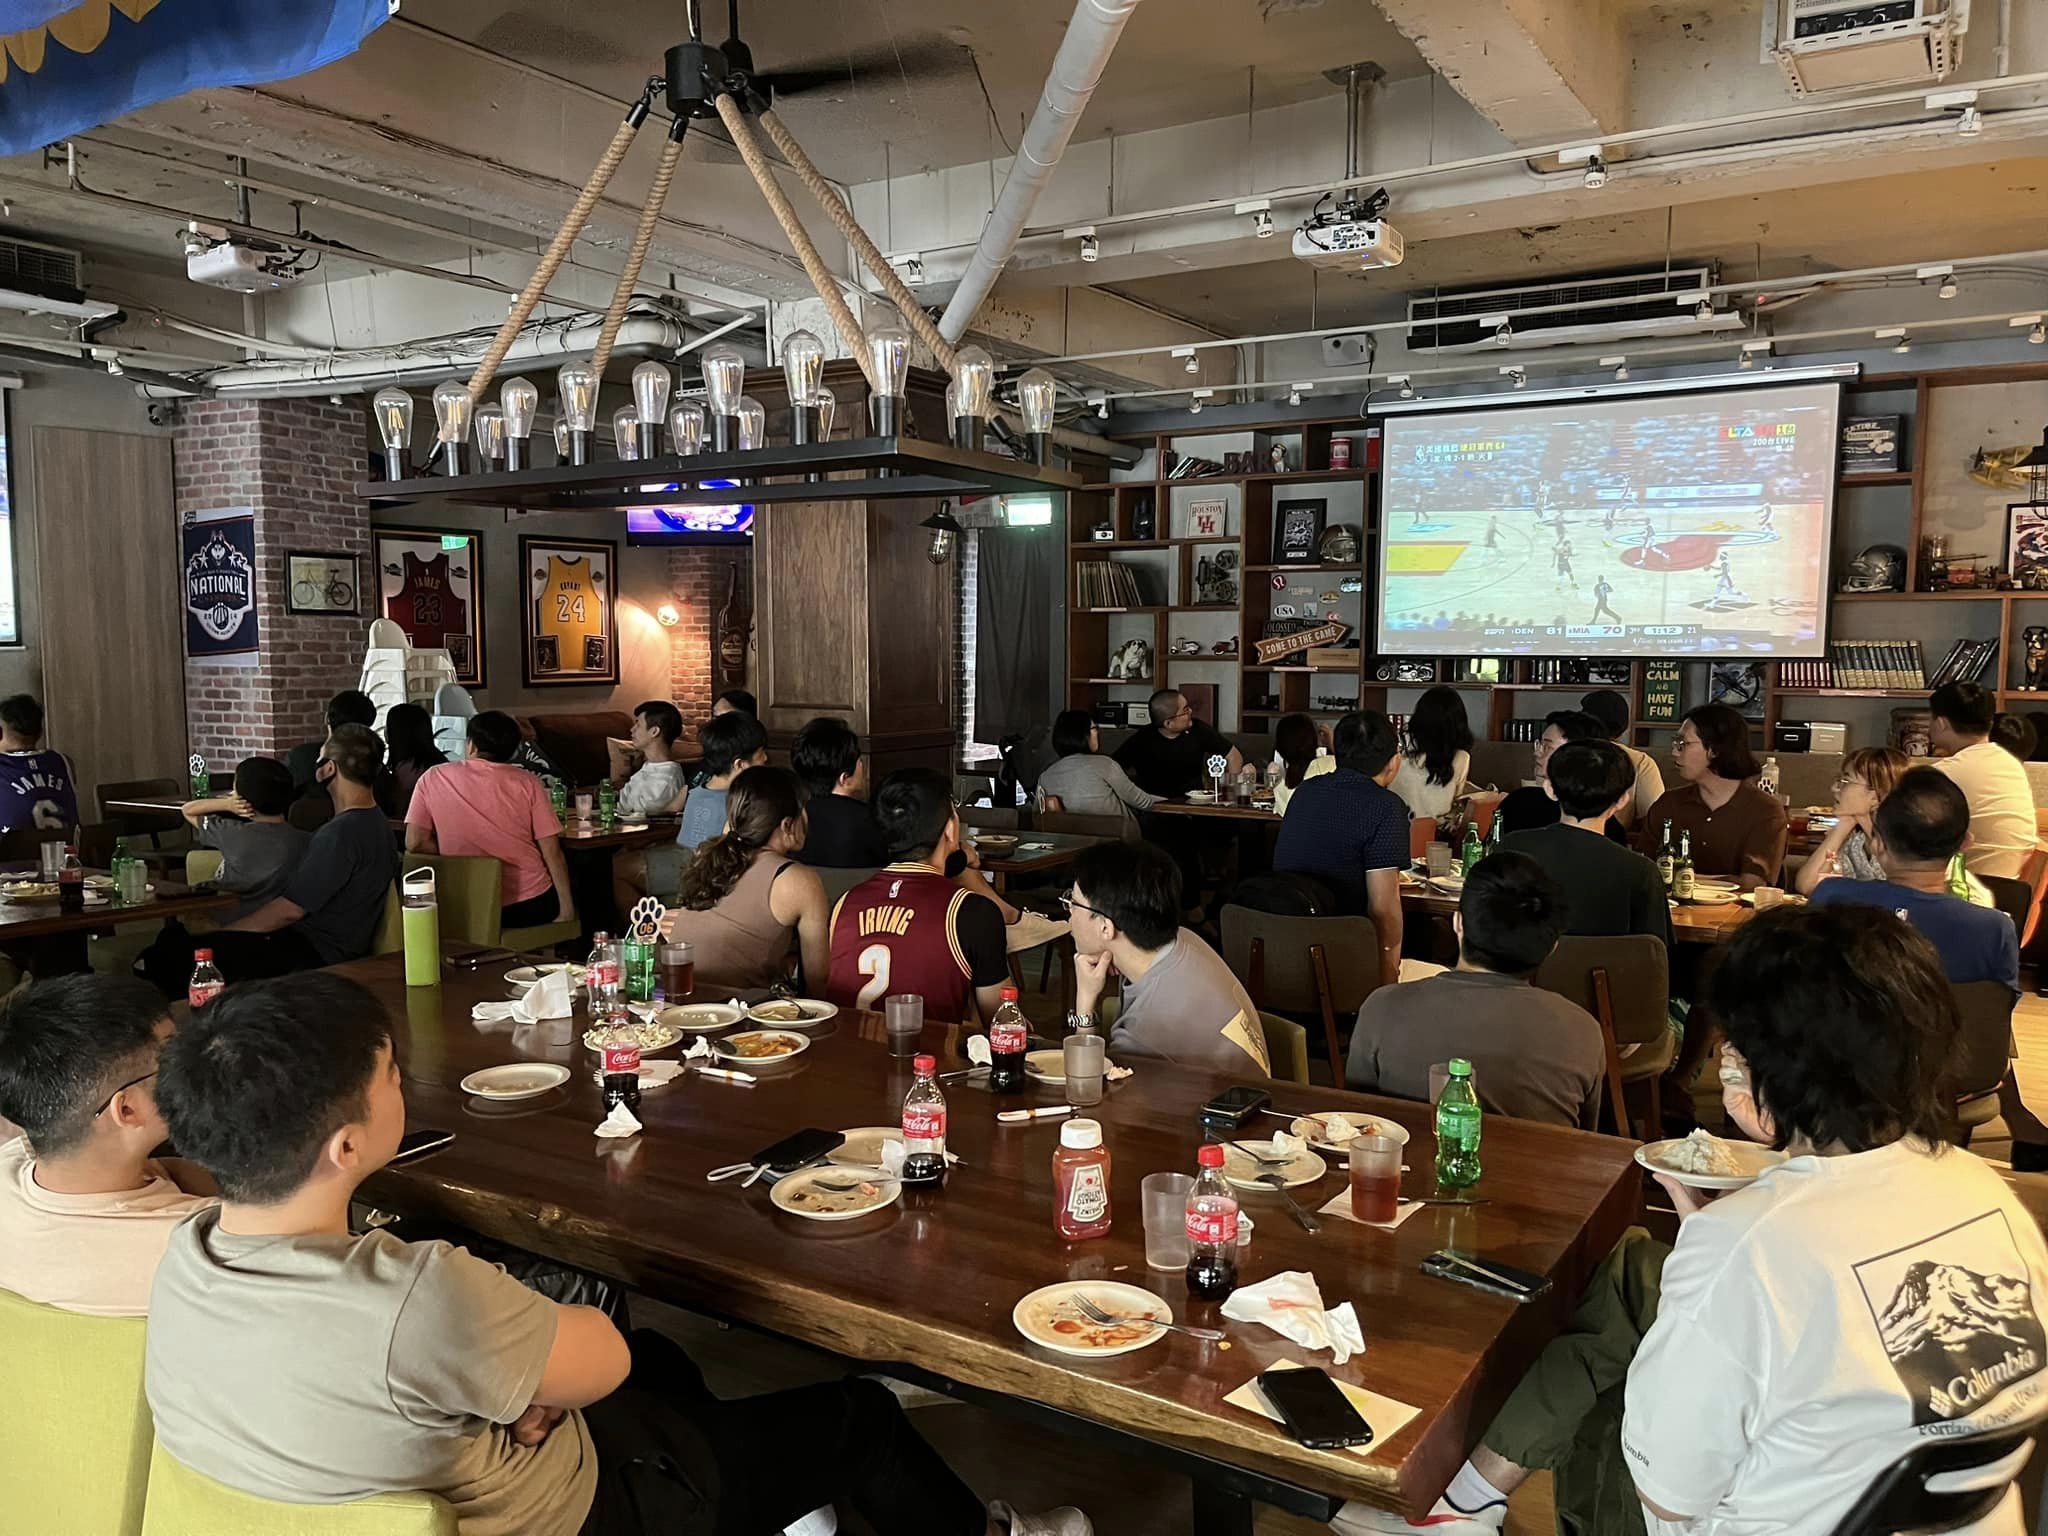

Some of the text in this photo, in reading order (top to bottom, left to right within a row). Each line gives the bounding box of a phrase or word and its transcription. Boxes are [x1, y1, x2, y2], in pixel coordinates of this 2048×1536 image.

[1192, 503, 1222, 517] HOUSTON
[190, 575, 246, 596] NATIONAL
[413, 592, 443, 625] 23
[557, 594, 586, 622] 24
[1276, 606, 1294, 615] USA
[1515, 627, 1562, 635] DEN 81
[1602, 626, 1622, 634] 70
[1287, 637, 1299, 649] TO
[1298, 632, 1313, 645] THE
[1314, 626, 1337, 641] GAME
[1646, 670, 1679, 680] CALM
[1647, 693, 1675, 704] HAVE
[1650, 706, 1672, 717] FUN
[11, 772, 63, 795] JAMES
[859, 905, 915, 936] IRVING
[640, 922, 654, 934] 06
[1947, 1346, 2037, 1408] Columbia
